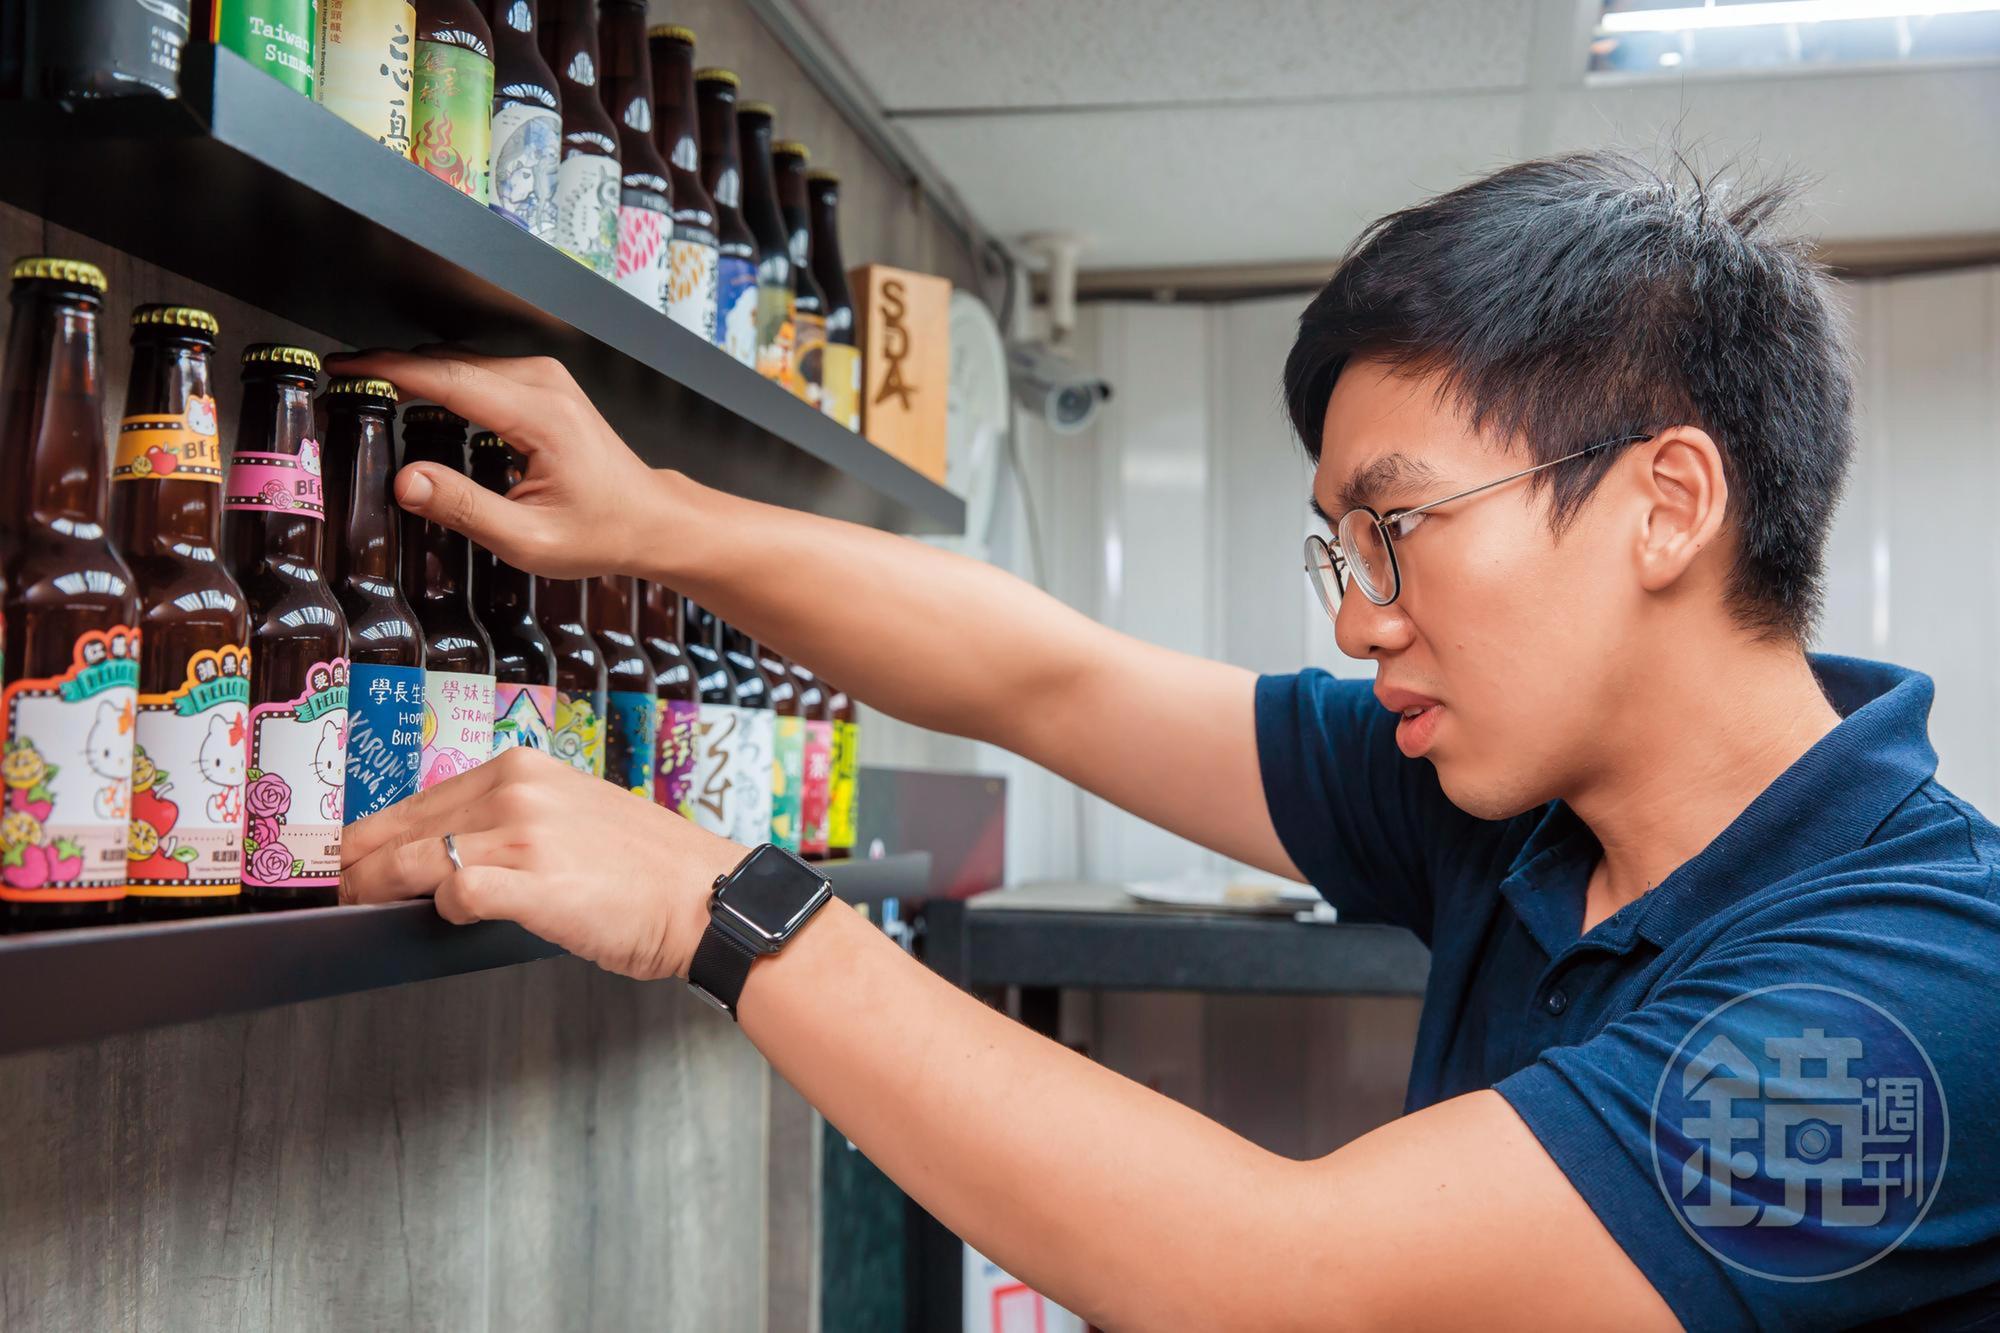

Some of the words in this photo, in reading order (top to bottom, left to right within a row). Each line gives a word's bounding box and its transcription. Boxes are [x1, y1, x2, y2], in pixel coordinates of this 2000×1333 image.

[249, 16, 310, 54] Taiwan
[265, 43, 315, 80] Summe
[183, 440, 220, 463] BEE
[441, 680, 496, 704] 學妹生
